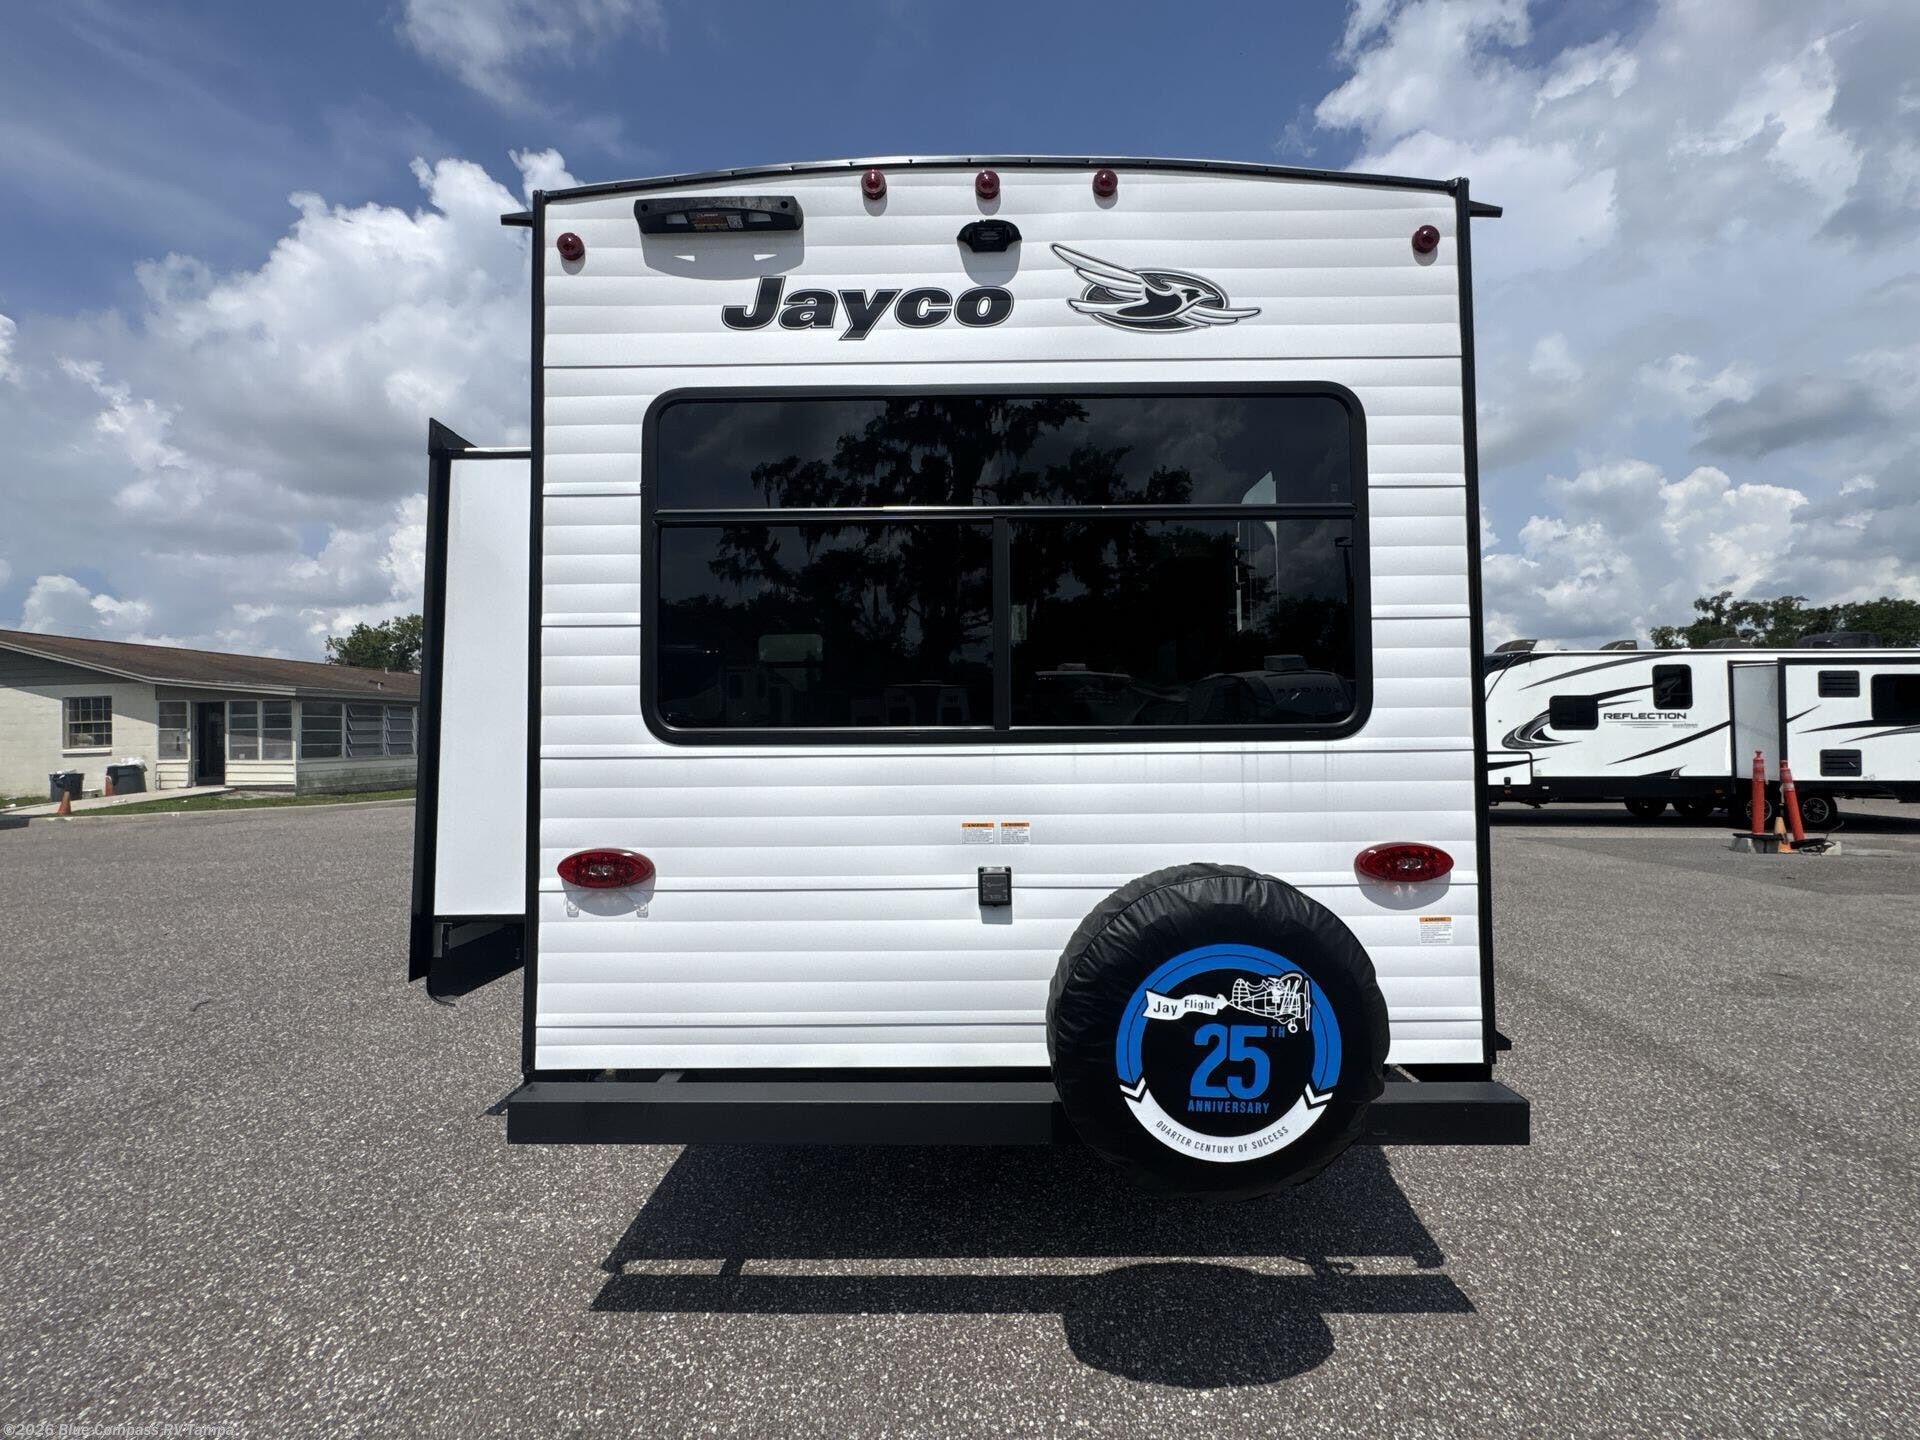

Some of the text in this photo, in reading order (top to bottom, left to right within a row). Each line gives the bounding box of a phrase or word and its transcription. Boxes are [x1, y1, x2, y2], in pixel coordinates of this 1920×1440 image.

[722, 275, 1015, 341] Jayco
[1603, 712, 1687, 720] REFLECTION
[1153, 999, 1215, 1016] Jay Flight
[1187, 1100, 1270, 1114] ANNIVERSARY
[1156, 1120, 1289, 1154] QUARTER CENTURY OF SUCCESS
